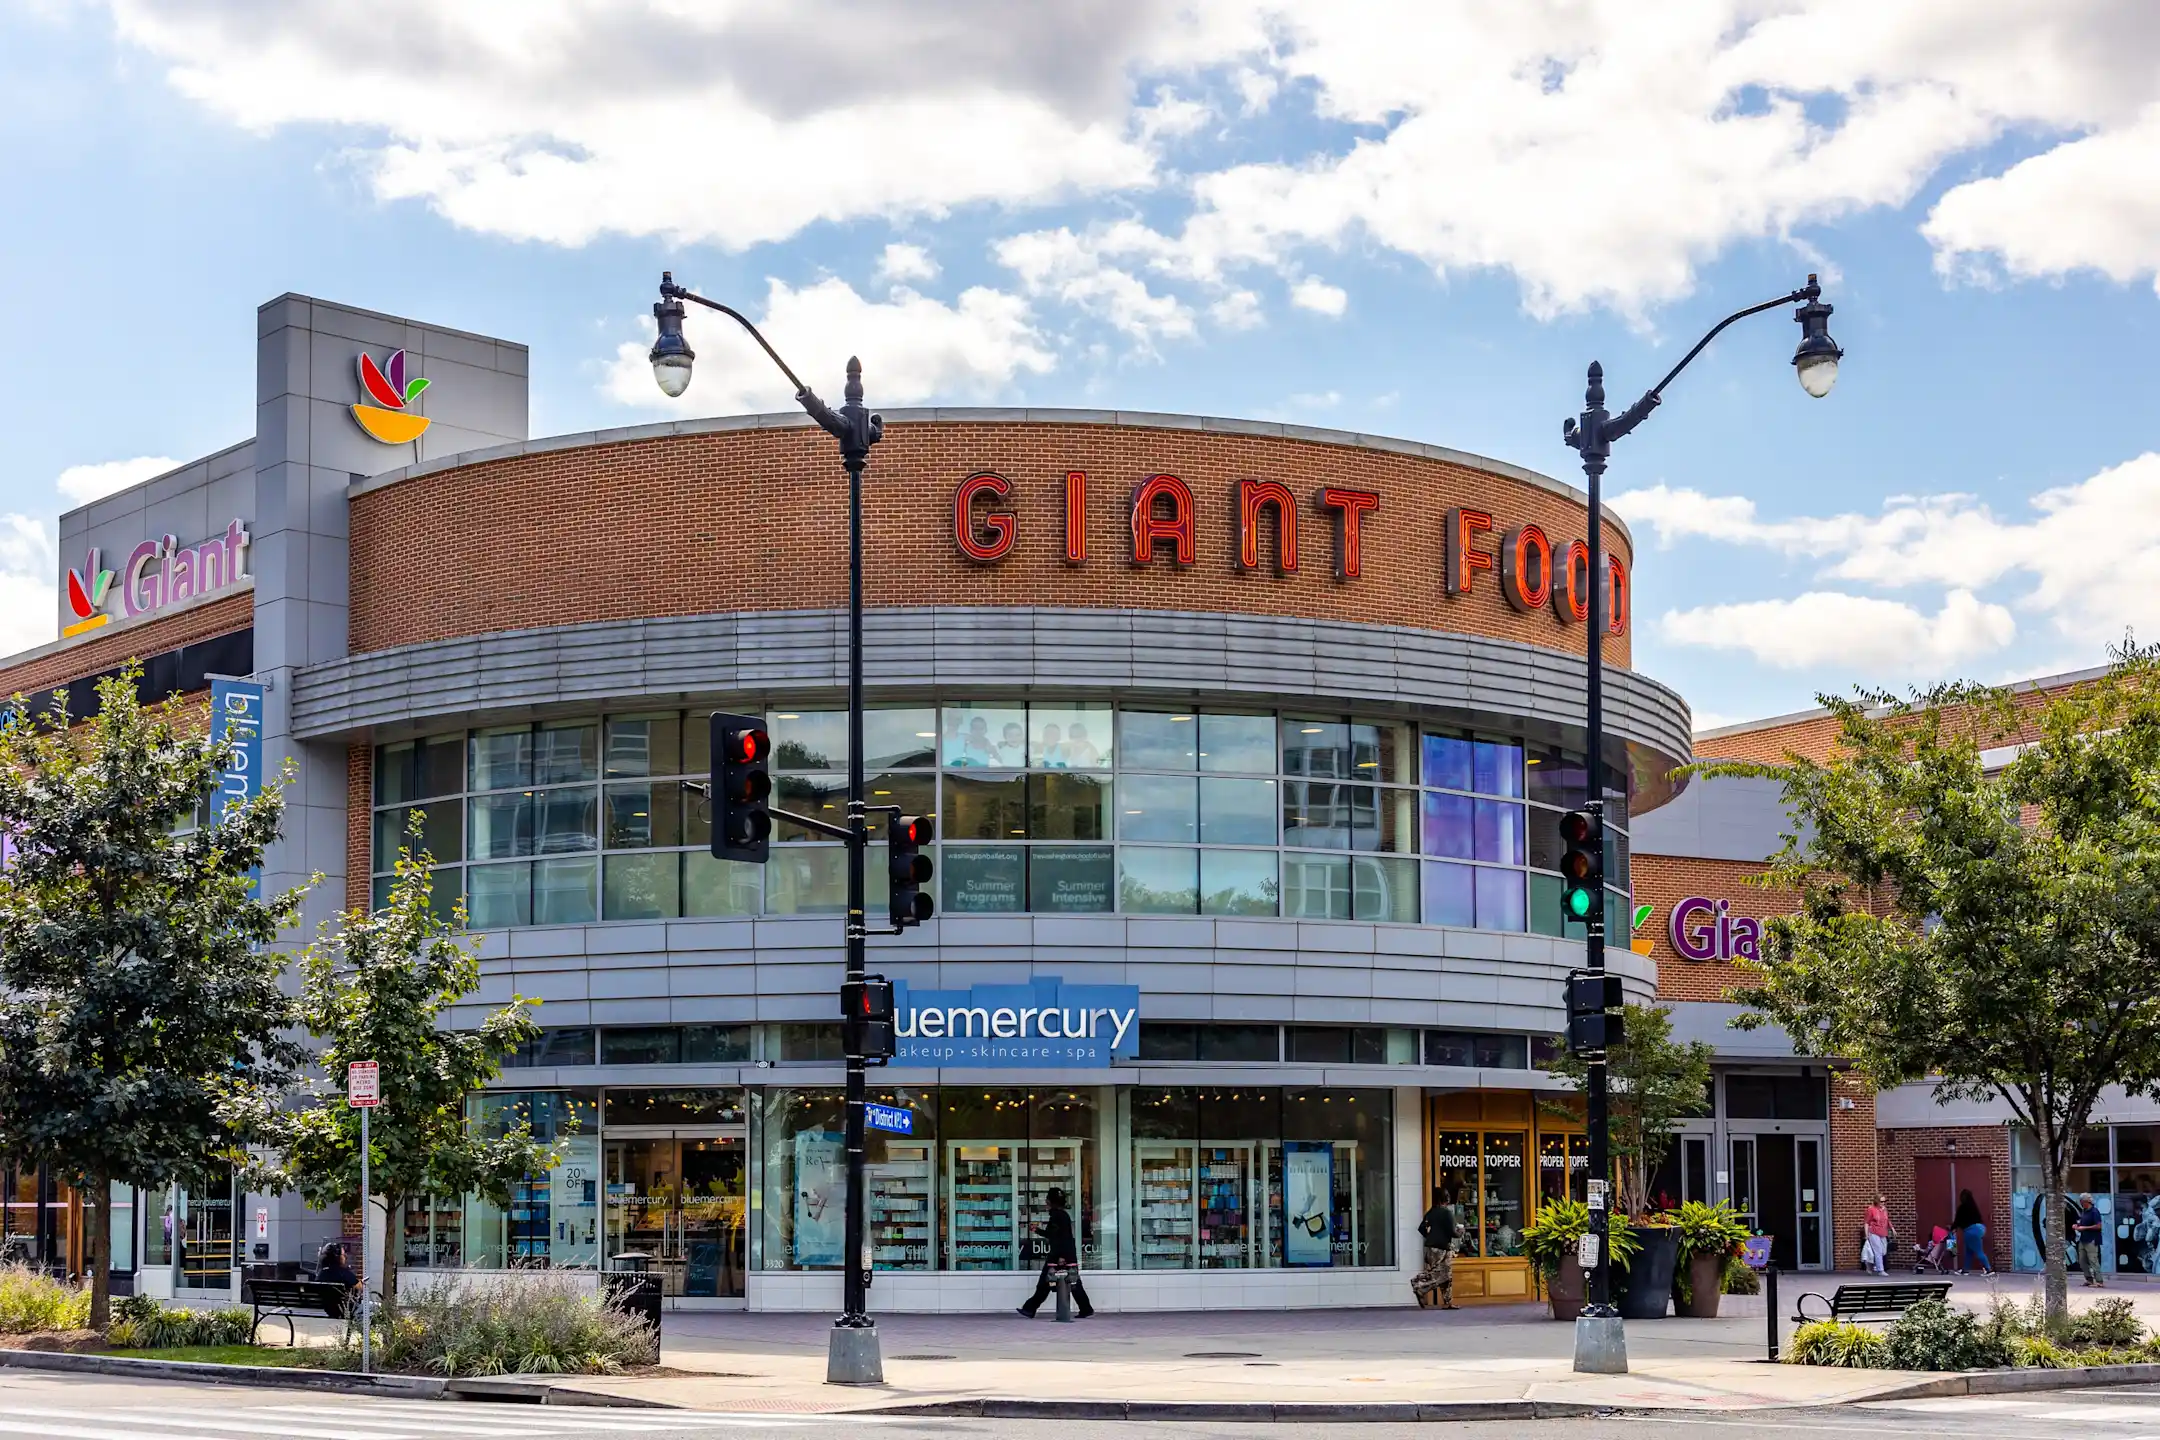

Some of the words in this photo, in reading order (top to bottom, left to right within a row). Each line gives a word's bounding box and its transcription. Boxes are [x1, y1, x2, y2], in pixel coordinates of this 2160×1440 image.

[953, 471, 1379, 580] GIANT
[1448, 507, 1626, 637] FOOD
[123, 518, 249, 618] Giant
[966, 879, 1016, 891] Summer
[1057, 880, 1105, 892] Summer
[956, 891, 1017, 904] Programs
[1052, 892, 1107, 903] Intensive
[1669, 896, 1763, 962] Gia
[893, 1007, 1136, 1050] uemercury
[900, 1044, 954, 1060] akeup
[971, 1044, 1050, 1058] skincare
[1066, 1047, 1096, 1060] spa
[1440, 1155, 1477, 1168] PROPER
[1485, 1155, 1521, 1168] TOPPER
[1540, 1155, 1564, 1168] PROPER
[1569, 1155, 1589, 1168] TOPPE
[566, 1179, 584, 1189] OFF
[607, 1194, 668, 1206] bluemercury
[680, 1194, 739, 1205] bluemercury
[257, 1213, 266, 1223] FDC
[944, 1241, 1024, 1256] buemercury
[764, 1259, 785, 1269] 3320
